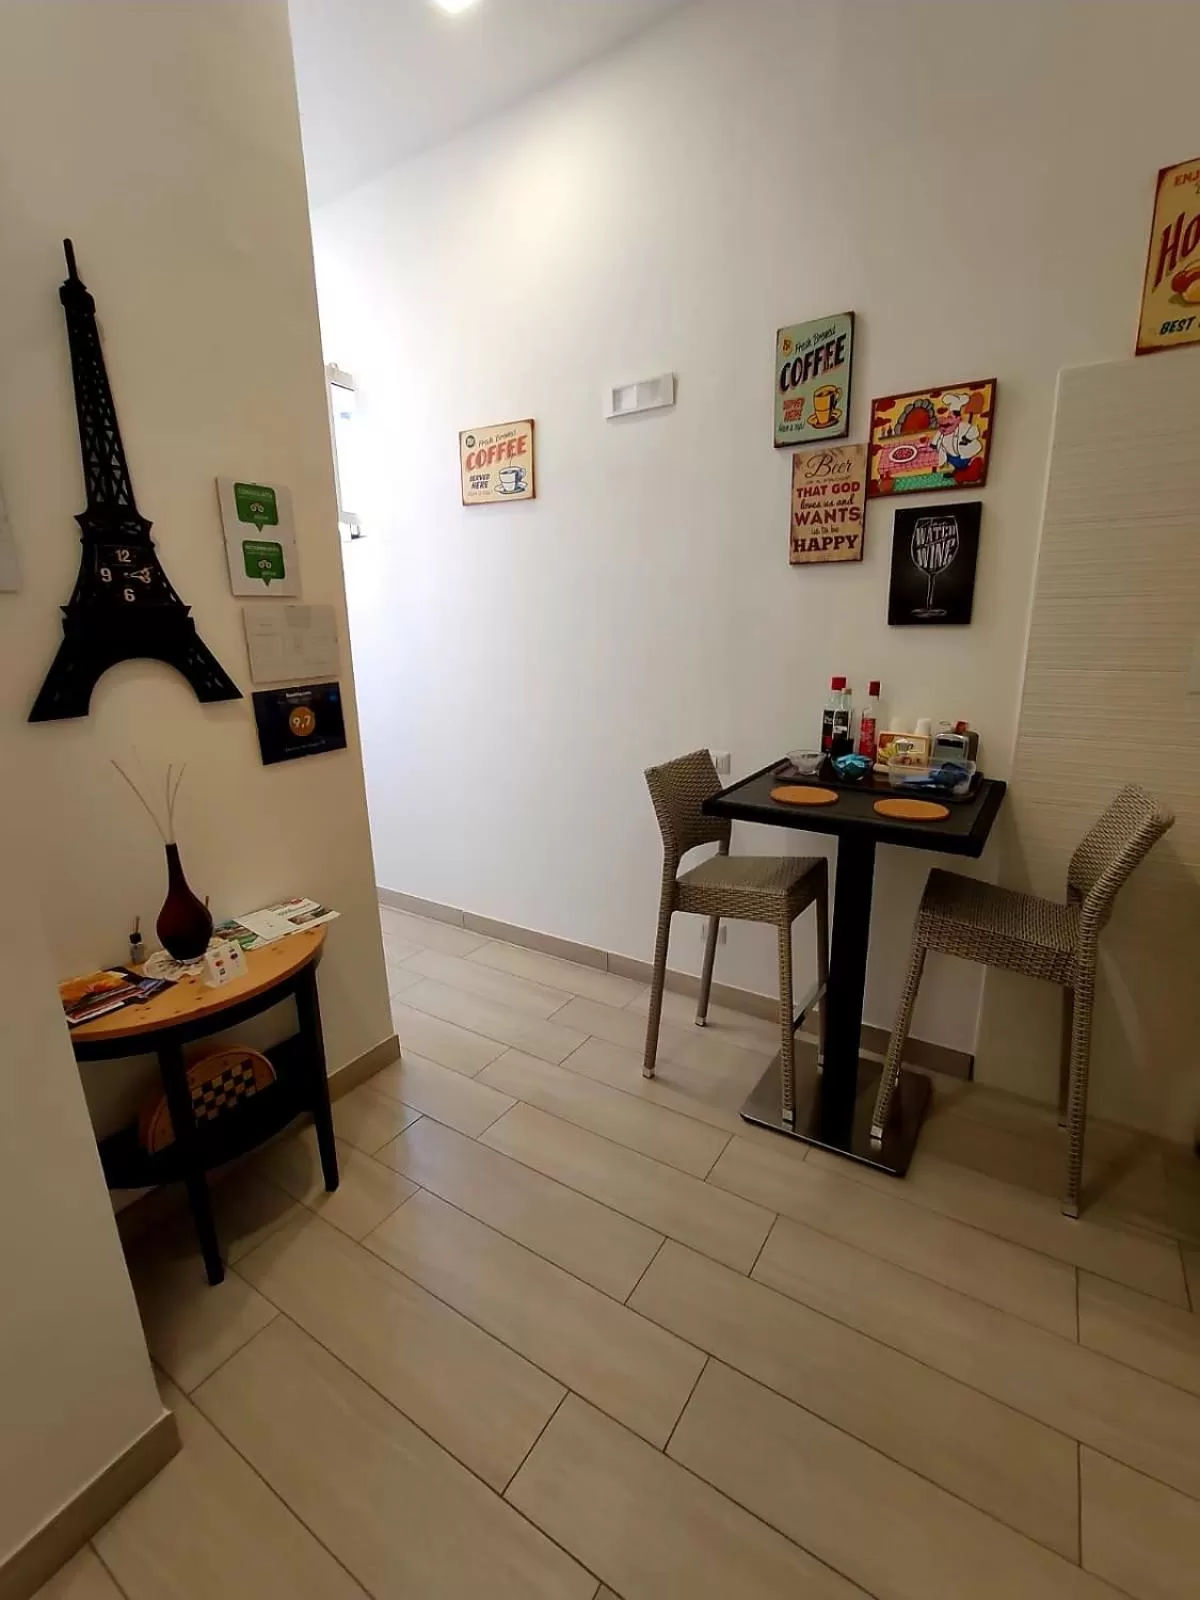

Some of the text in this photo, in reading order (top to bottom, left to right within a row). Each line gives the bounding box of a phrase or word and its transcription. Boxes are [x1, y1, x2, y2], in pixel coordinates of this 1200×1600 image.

[1160, 316, 1196, 335] BEST
[780, 333, 847, 392] COFFEE
[467, 435, 528, 471] COFFEE
[805, 455, 853, 478] Beer
[796, 481, 861, 498] THAT GOD
[836, 493, 854, 506] and
[794, 506, 861, 526] WANTS
[793, 534, 859, 553] HAPPY
[115, 549, 132, 563] 12
[100, 567, 113, 582] 9
[123, 588, 136, 602] 6
